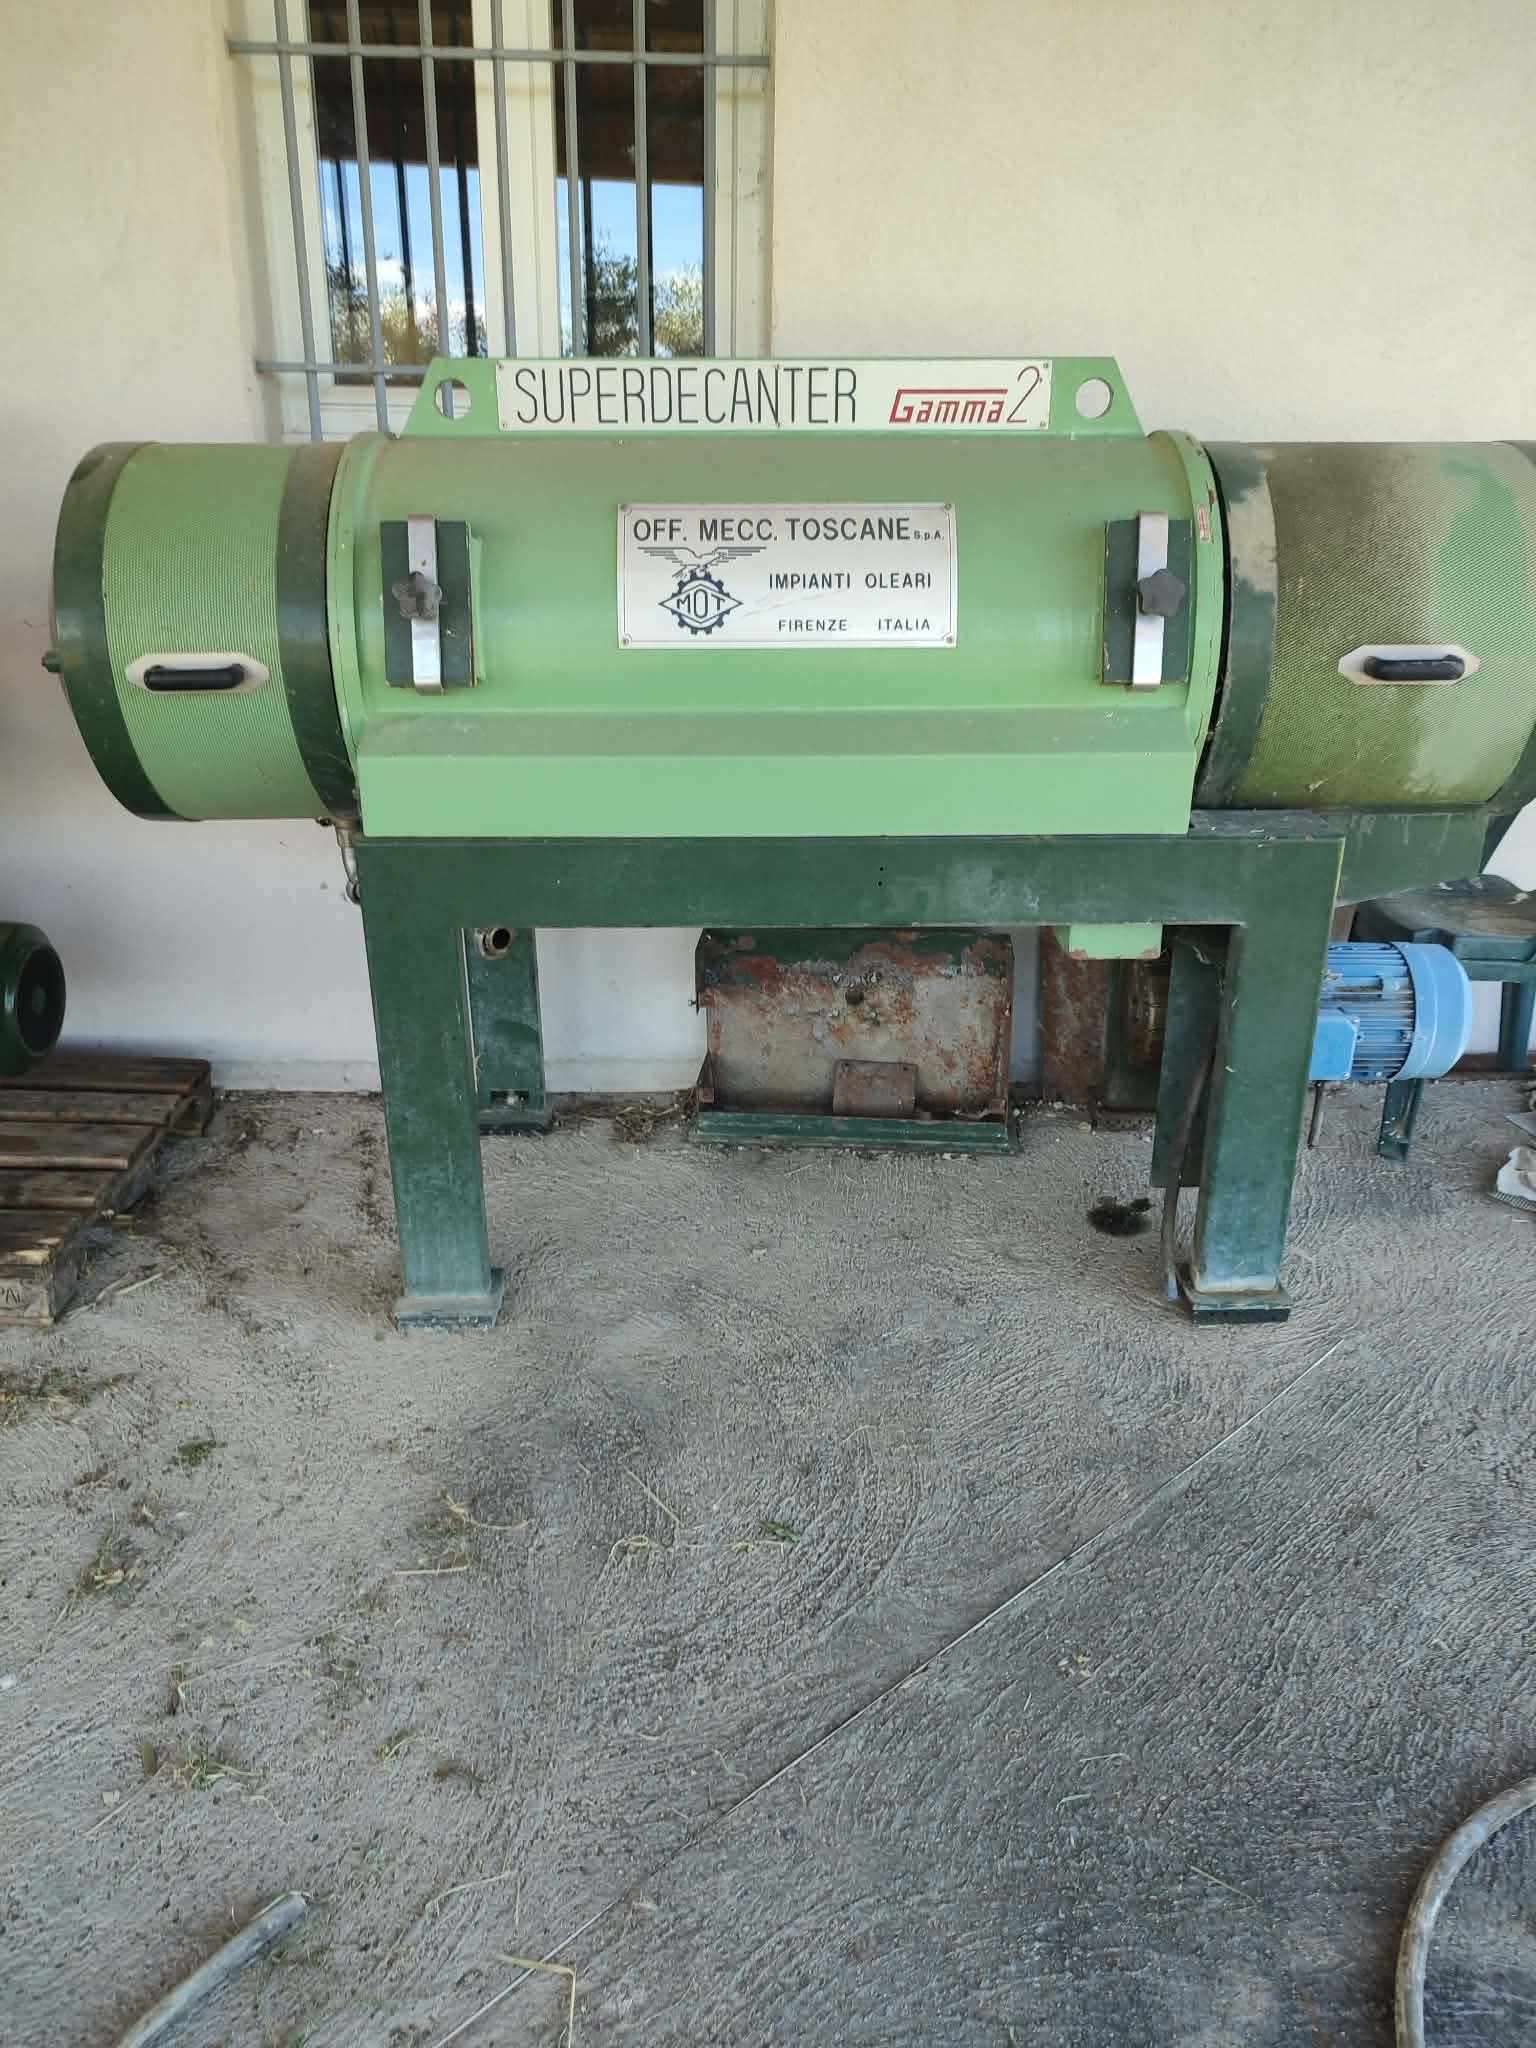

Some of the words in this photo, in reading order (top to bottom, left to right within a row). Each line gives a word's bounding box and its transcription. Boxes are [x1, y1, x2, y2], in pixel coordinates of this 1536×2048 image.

[514, 367, 857, 424] SUPERDECANTER
[889, 388, 1008, 424] Gamma
[1006, 366, 1040, 423] 2
[633, 518, 687, 542] OFF.
[700, 518, 778, 542] MECC.
[785, 517, 911, 541] TOSCANE
[769, 573, 850, 589] IMPIANTI
[864, 572, 931, 589] OLEARI
[676, 588, 726, 619] MOT
[778, 618, 848, 632] FIRENZE
[878, 618, 930, 631] ITALIA
